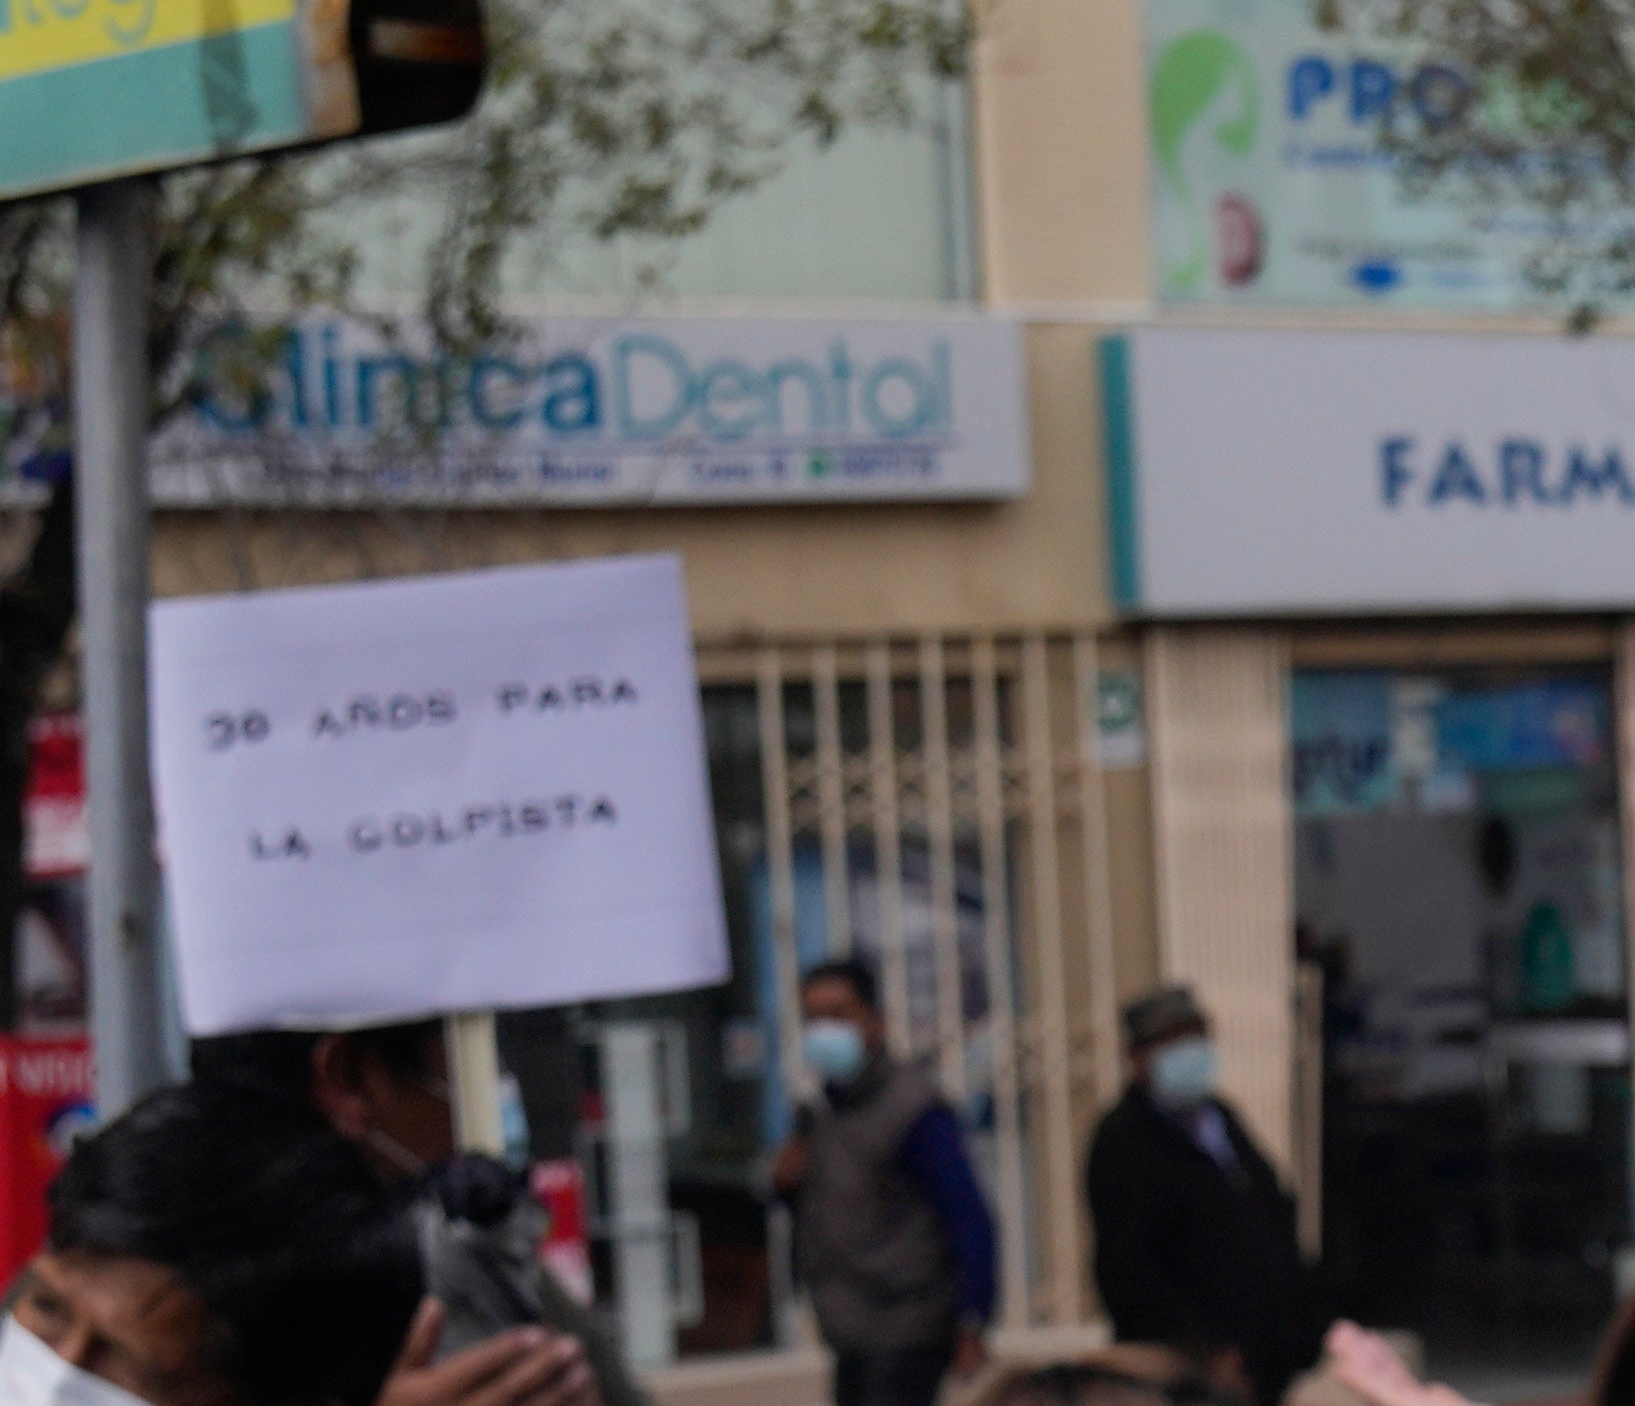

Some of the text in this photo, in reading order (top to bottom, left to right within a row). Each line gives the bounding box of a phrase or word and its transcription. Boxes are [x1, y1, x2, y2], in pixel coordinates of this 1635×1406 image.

[498, 673, 638, 715] PARA
[248, 793, 617, 862] LA GOLPISTA
